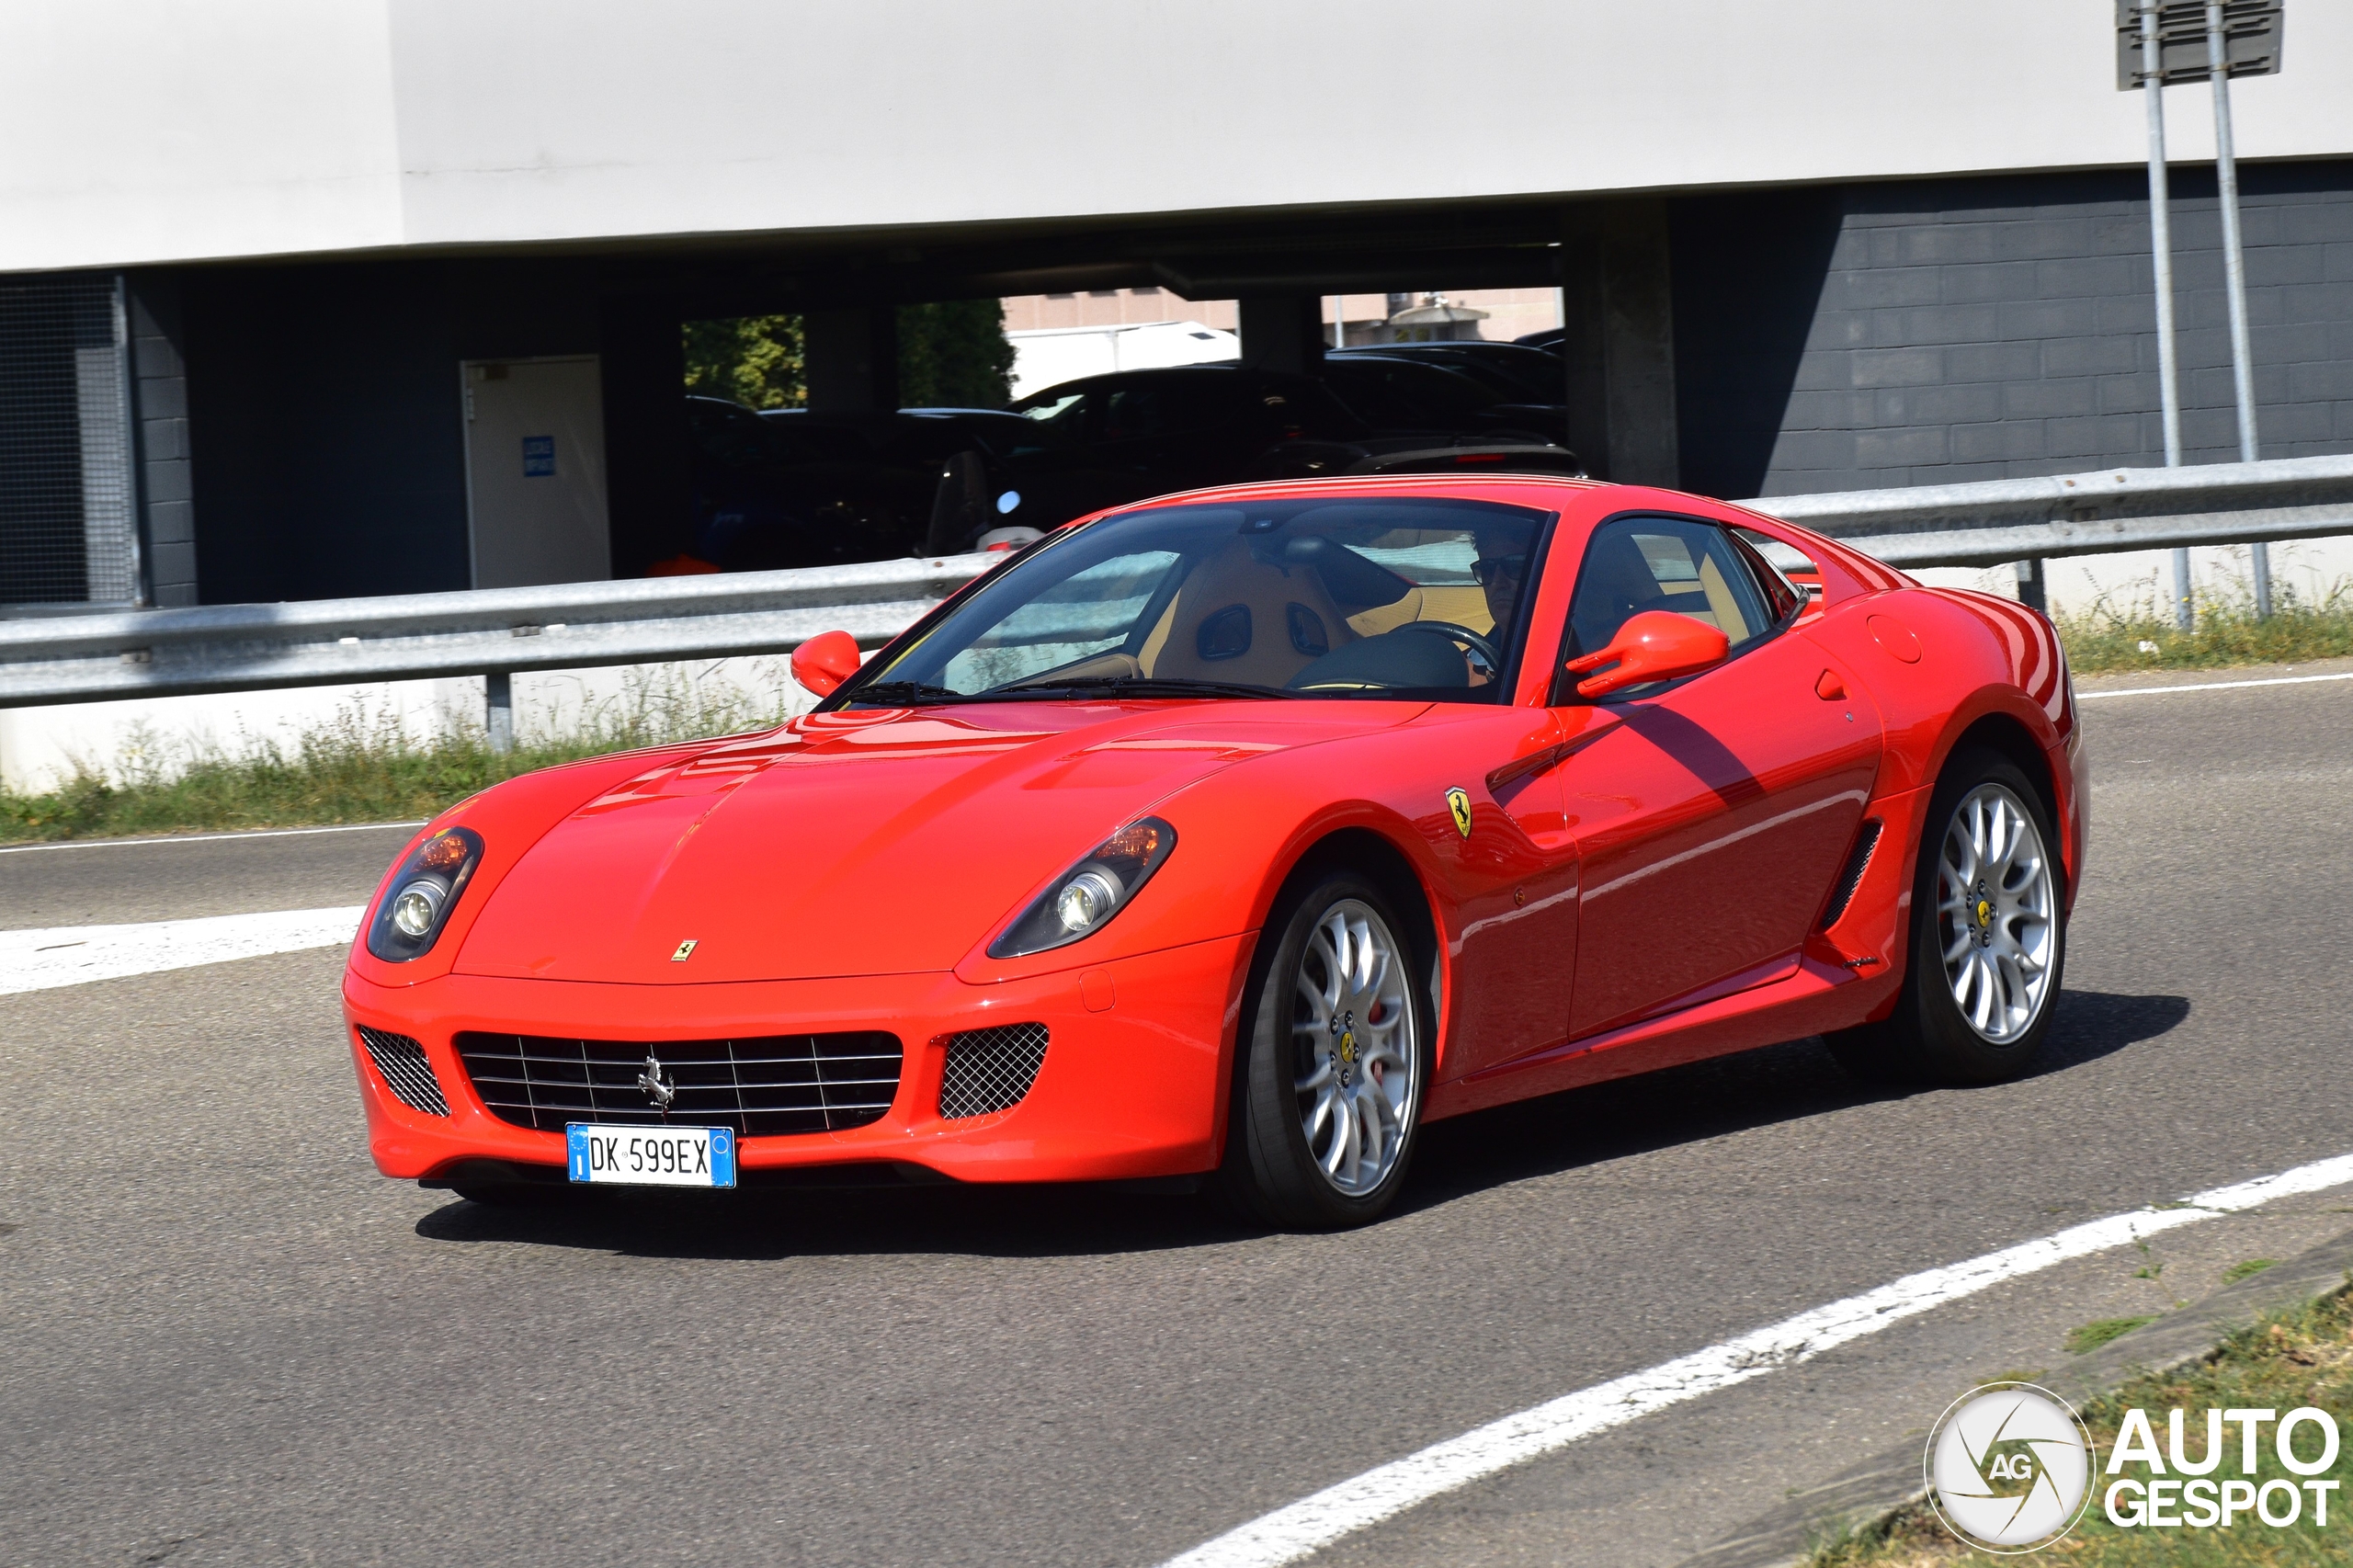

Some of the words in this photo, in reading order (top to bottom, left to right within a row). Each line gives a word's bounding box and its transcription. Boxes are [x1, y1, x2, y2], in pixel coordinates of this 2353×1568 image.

[576, 1154, 583, 1176] I
[590, 1137, 620, 1172] DK
[630, 1138, 708, 1174] 599EX
